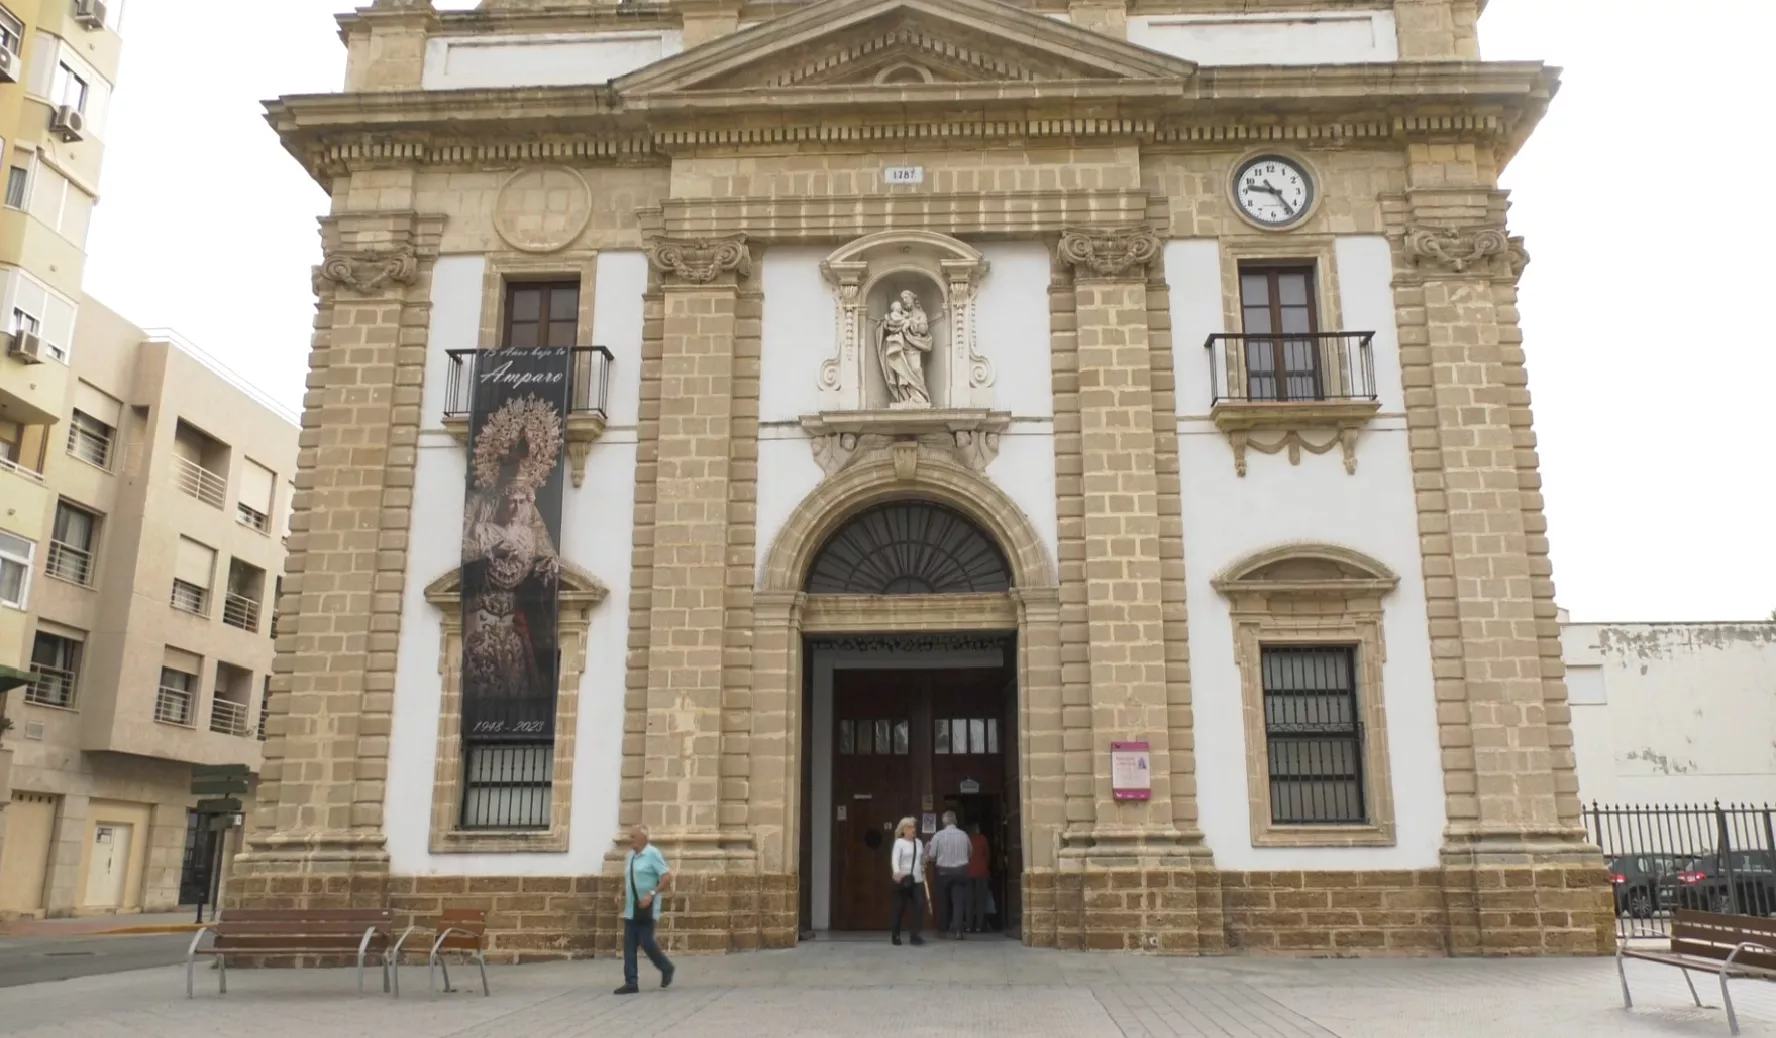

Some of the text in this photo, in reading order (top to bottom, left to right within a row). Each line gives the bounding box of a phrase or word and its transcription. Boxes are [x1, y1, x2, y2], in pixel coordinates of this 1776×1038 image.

[1254, 168, 1262, 176] 11
[1266, 165, 1276, 173] 12
[1246, 177, 1255, 185] 10
[1290, 176, 1297, 184] 2
[480, 360, 563, 390] Amparo
[472, 720, 504, 732] 1948
[512, 720, 545, 732] 2023
